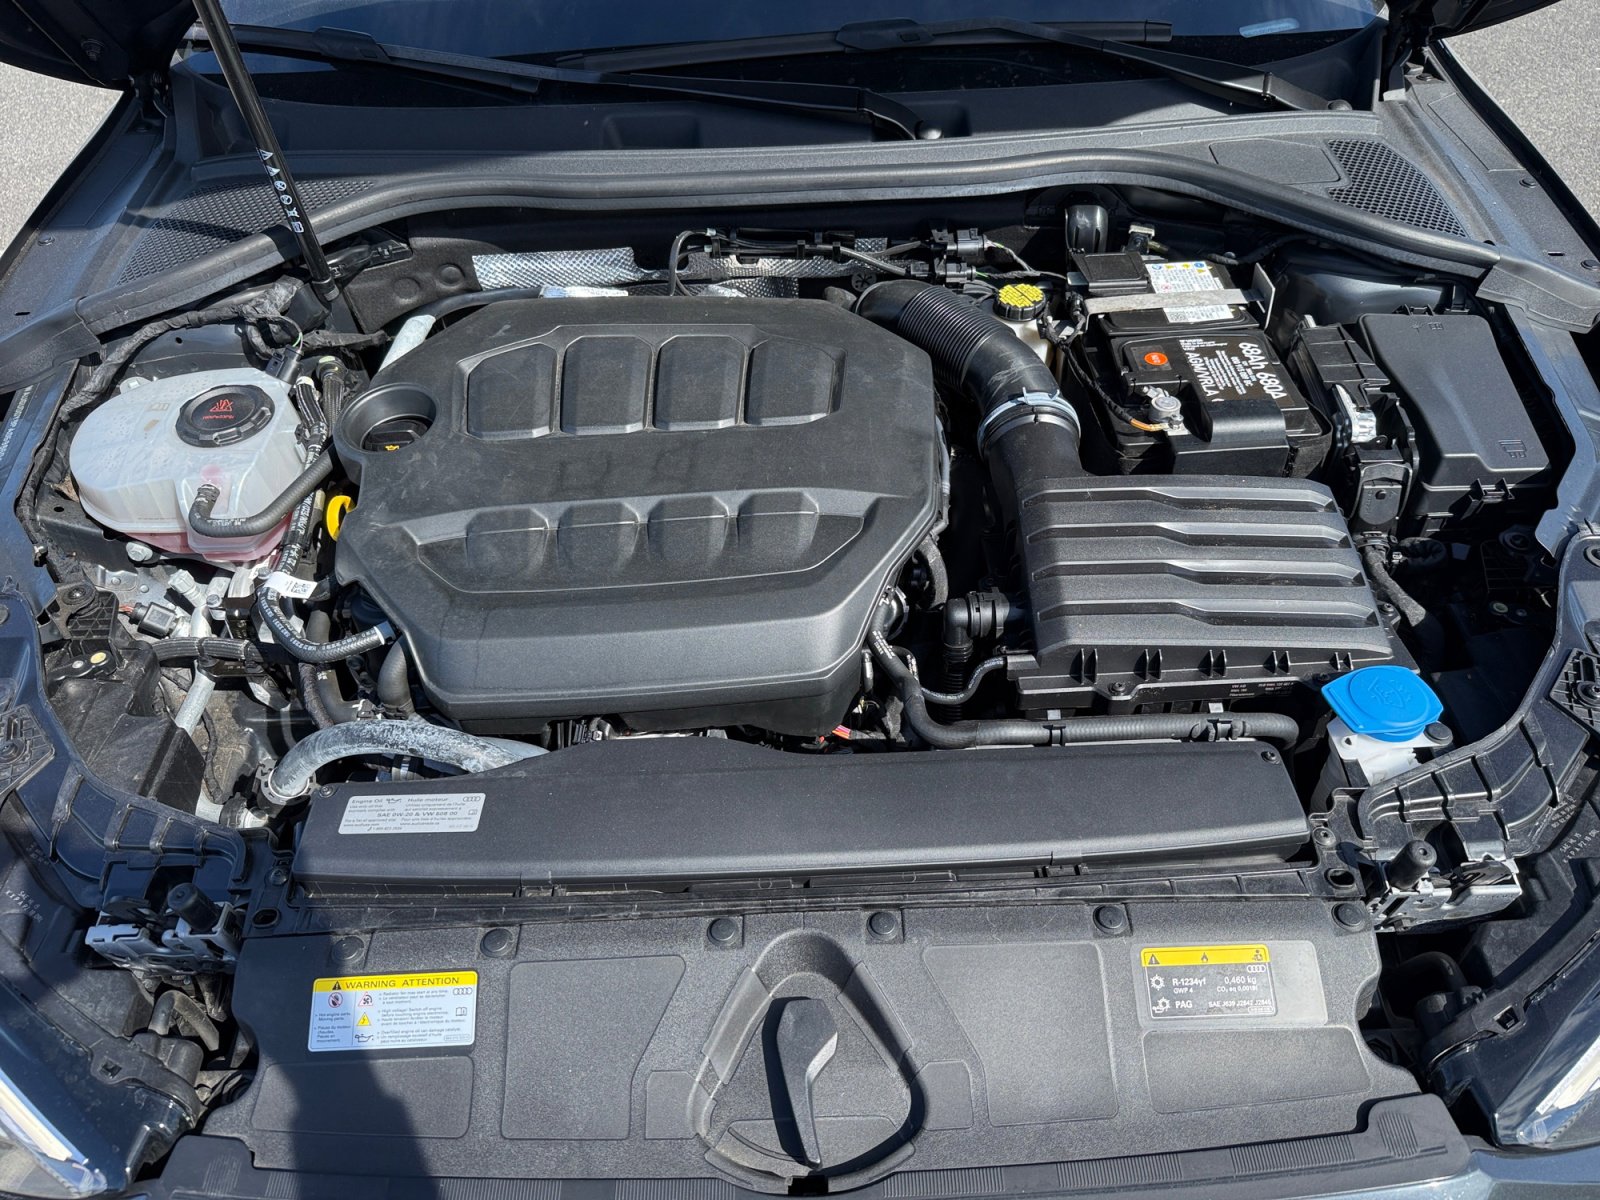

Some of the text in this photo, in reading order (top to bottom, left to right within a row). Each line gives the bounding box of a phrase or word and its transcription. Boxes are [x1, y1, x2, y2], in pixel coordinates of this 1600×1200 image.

[1186, 352, 1219, 397] AGM/VRLA
[1239, 342, 1287, 400] 68Ah 680A
[346, 977, 459, 989] WARNING ATTENTION
[1172, 977, 1206, 987] R-1234yf
[1247, 976, 1257, 984] kg
[1175, 1001, 1193, 1009] PAG
